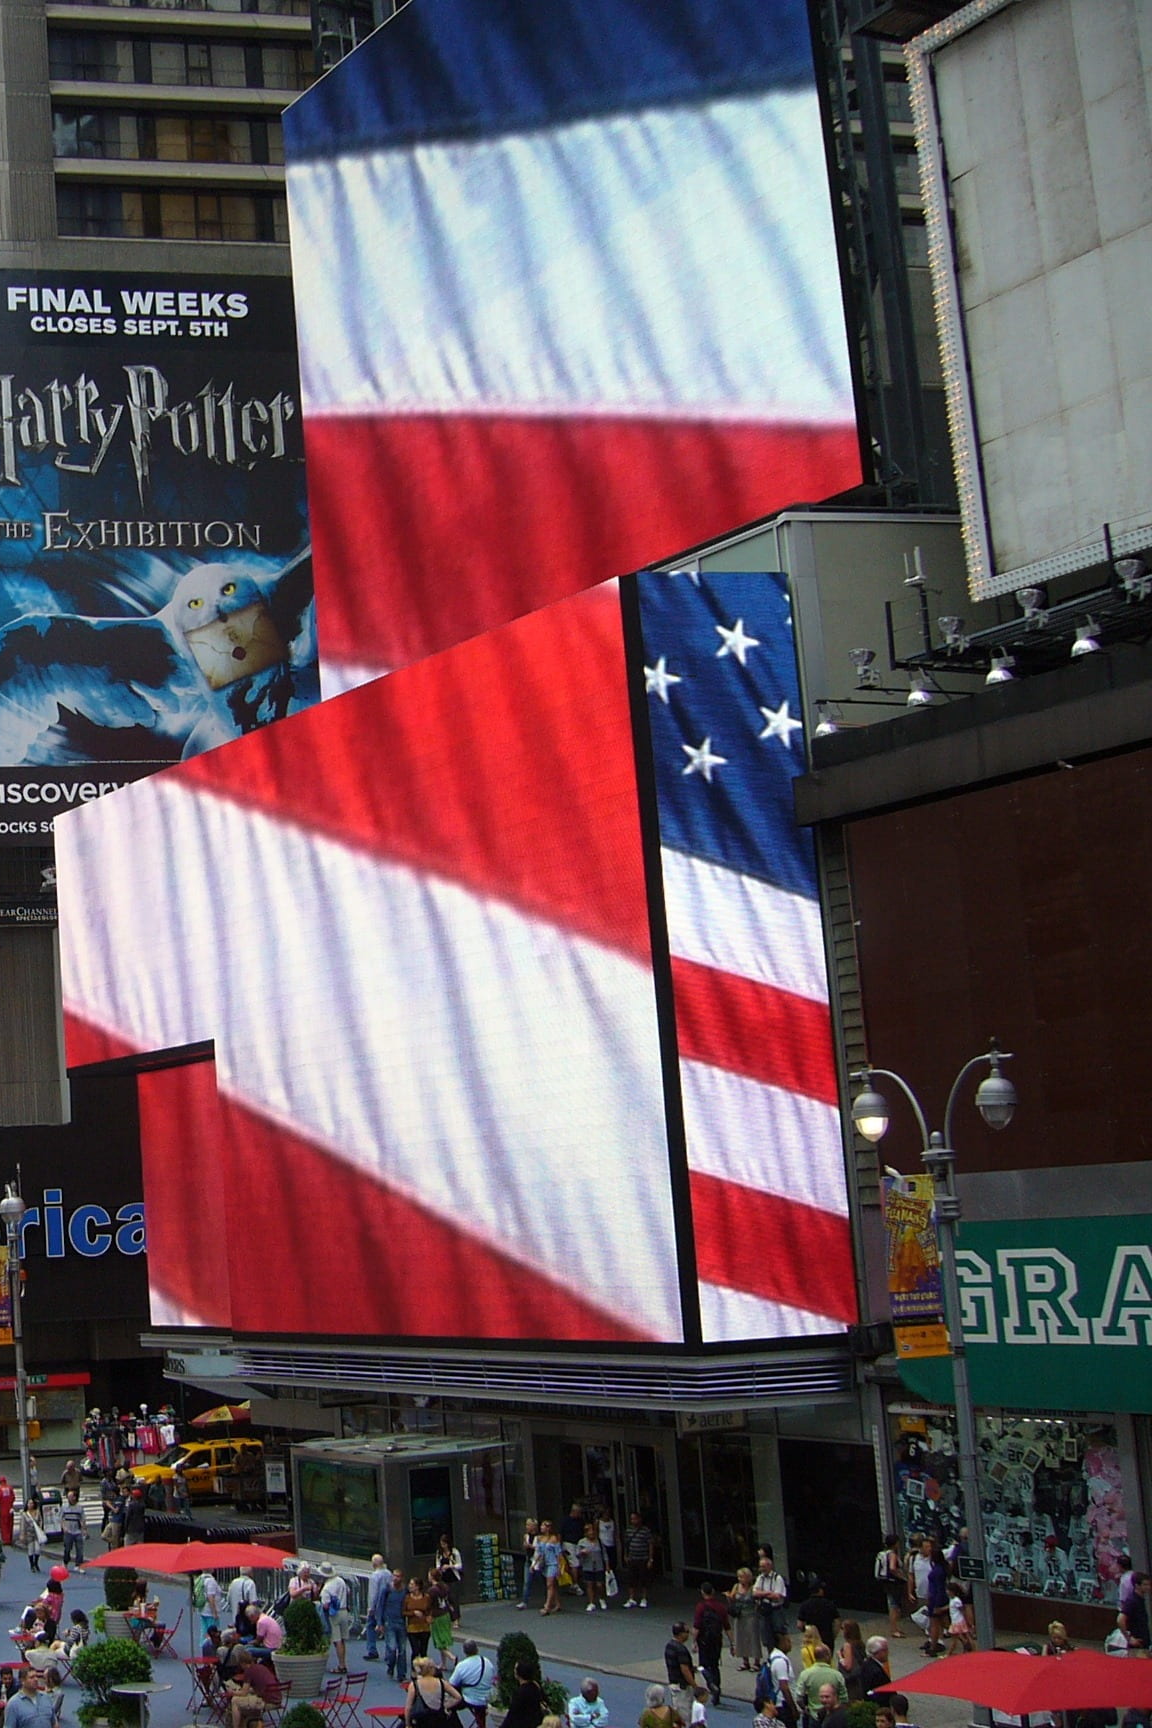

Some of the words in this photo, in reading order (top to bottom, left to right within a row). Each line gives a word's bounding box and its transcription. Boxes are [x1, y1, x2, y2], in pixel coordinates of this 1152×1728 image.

[7, 286, 111, 314] FINAL
[120, 290, 249, 318] WEEKS
[30, 316, 117, 335] CLOSES
[123, 319, 183, 336] SEPT.
[189, 320, 229, 337] 5TH
[122, 365, 295, 514] Potter
[41, 509, 261, 551] EXHIBITION
